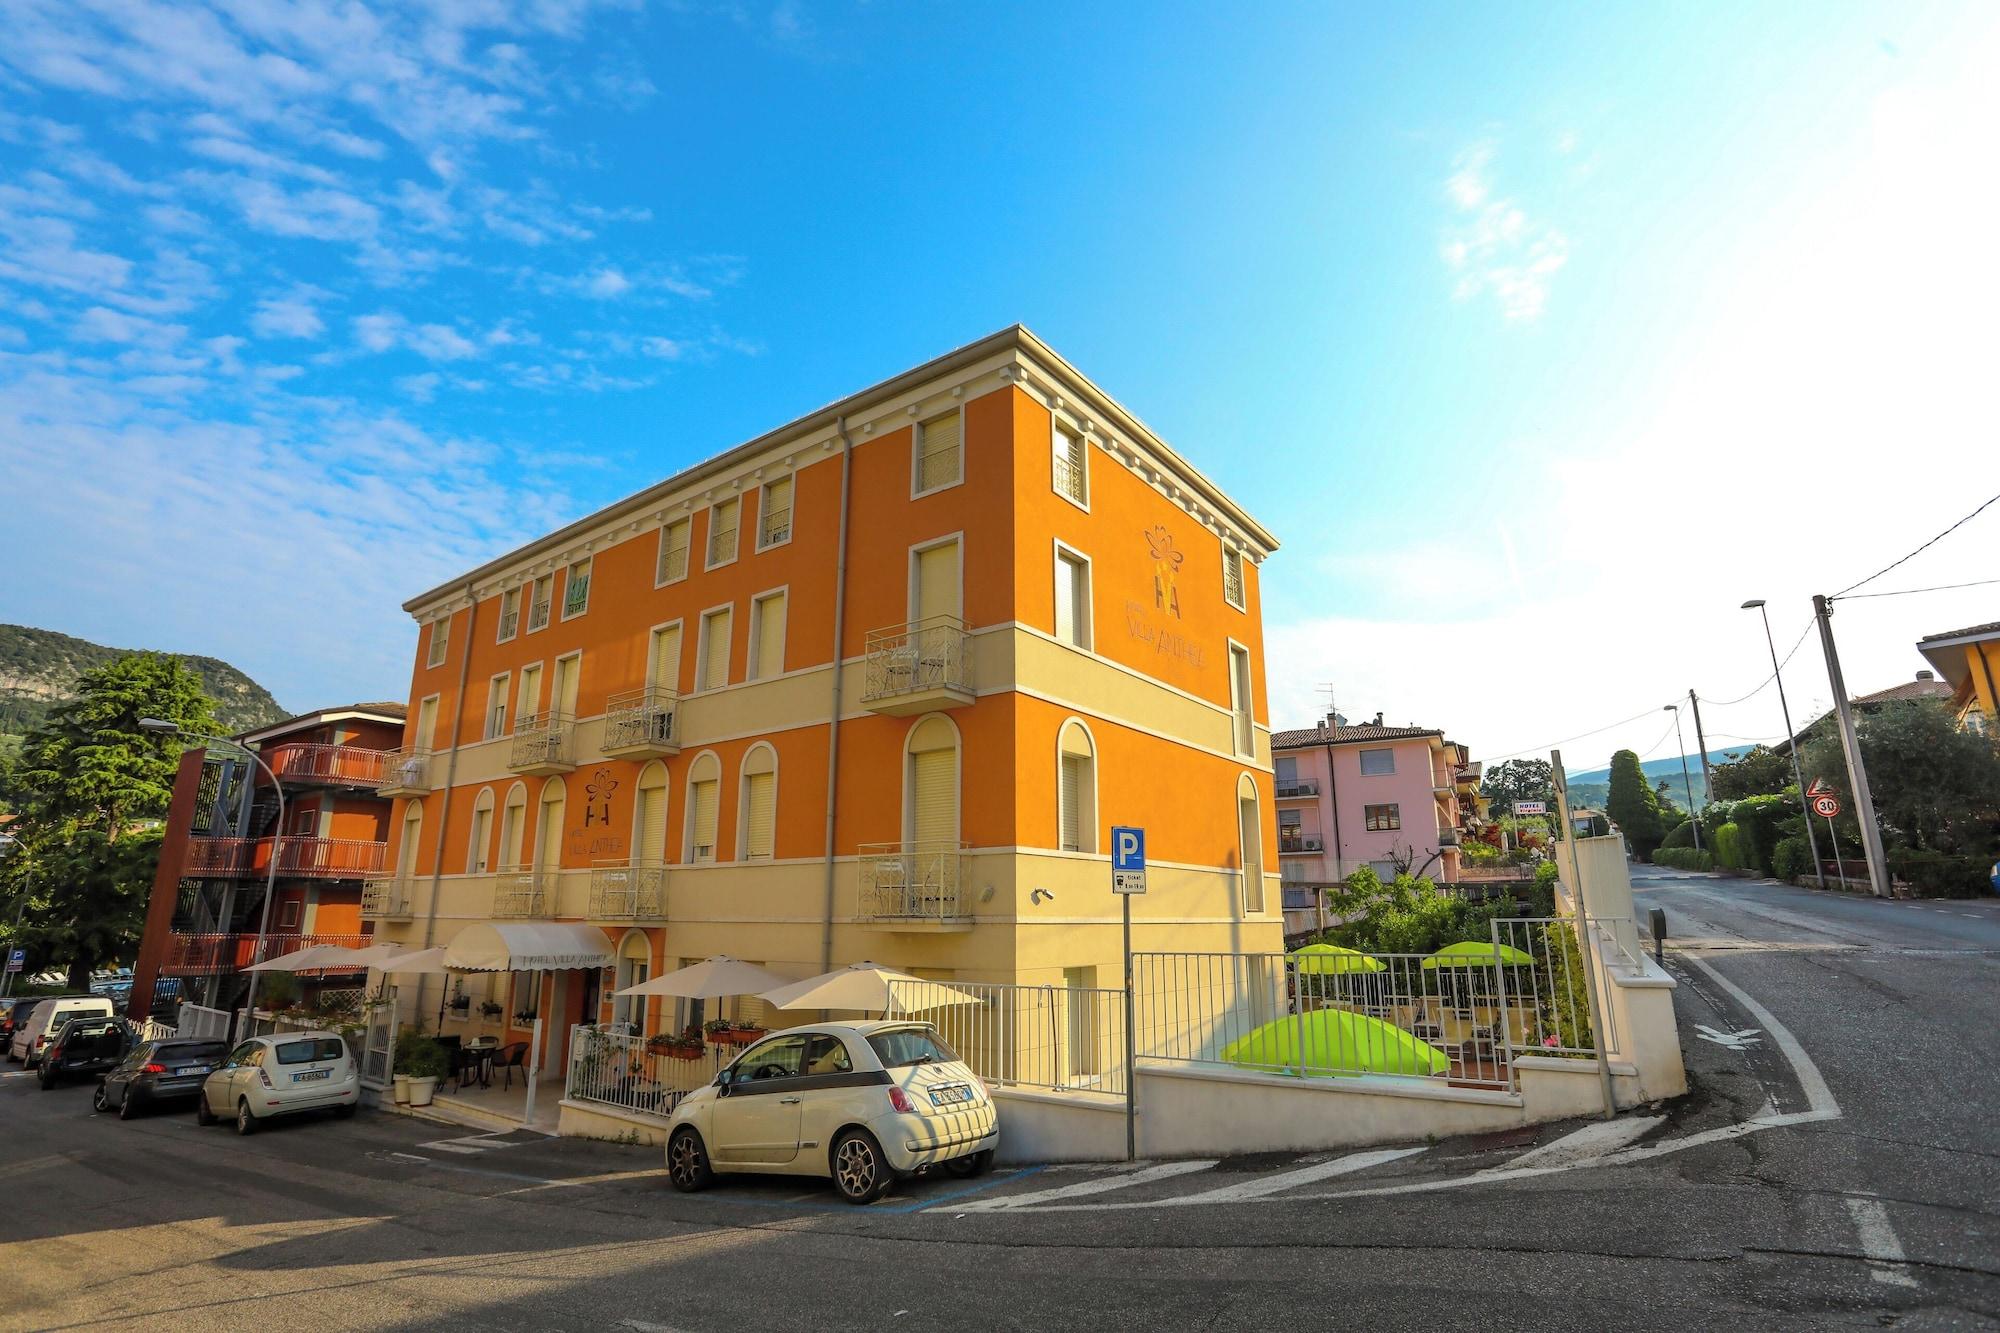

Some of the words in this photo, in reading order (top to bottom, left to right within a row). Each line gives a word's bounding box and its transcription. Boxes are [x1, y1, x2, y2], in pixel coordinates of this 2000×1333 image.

[1820, 801, 1834, 811] 30
[1119, 832, 1139, 866] P
[13, 951, 23, 960] P
[553, 953, 576, 967] VILLA
